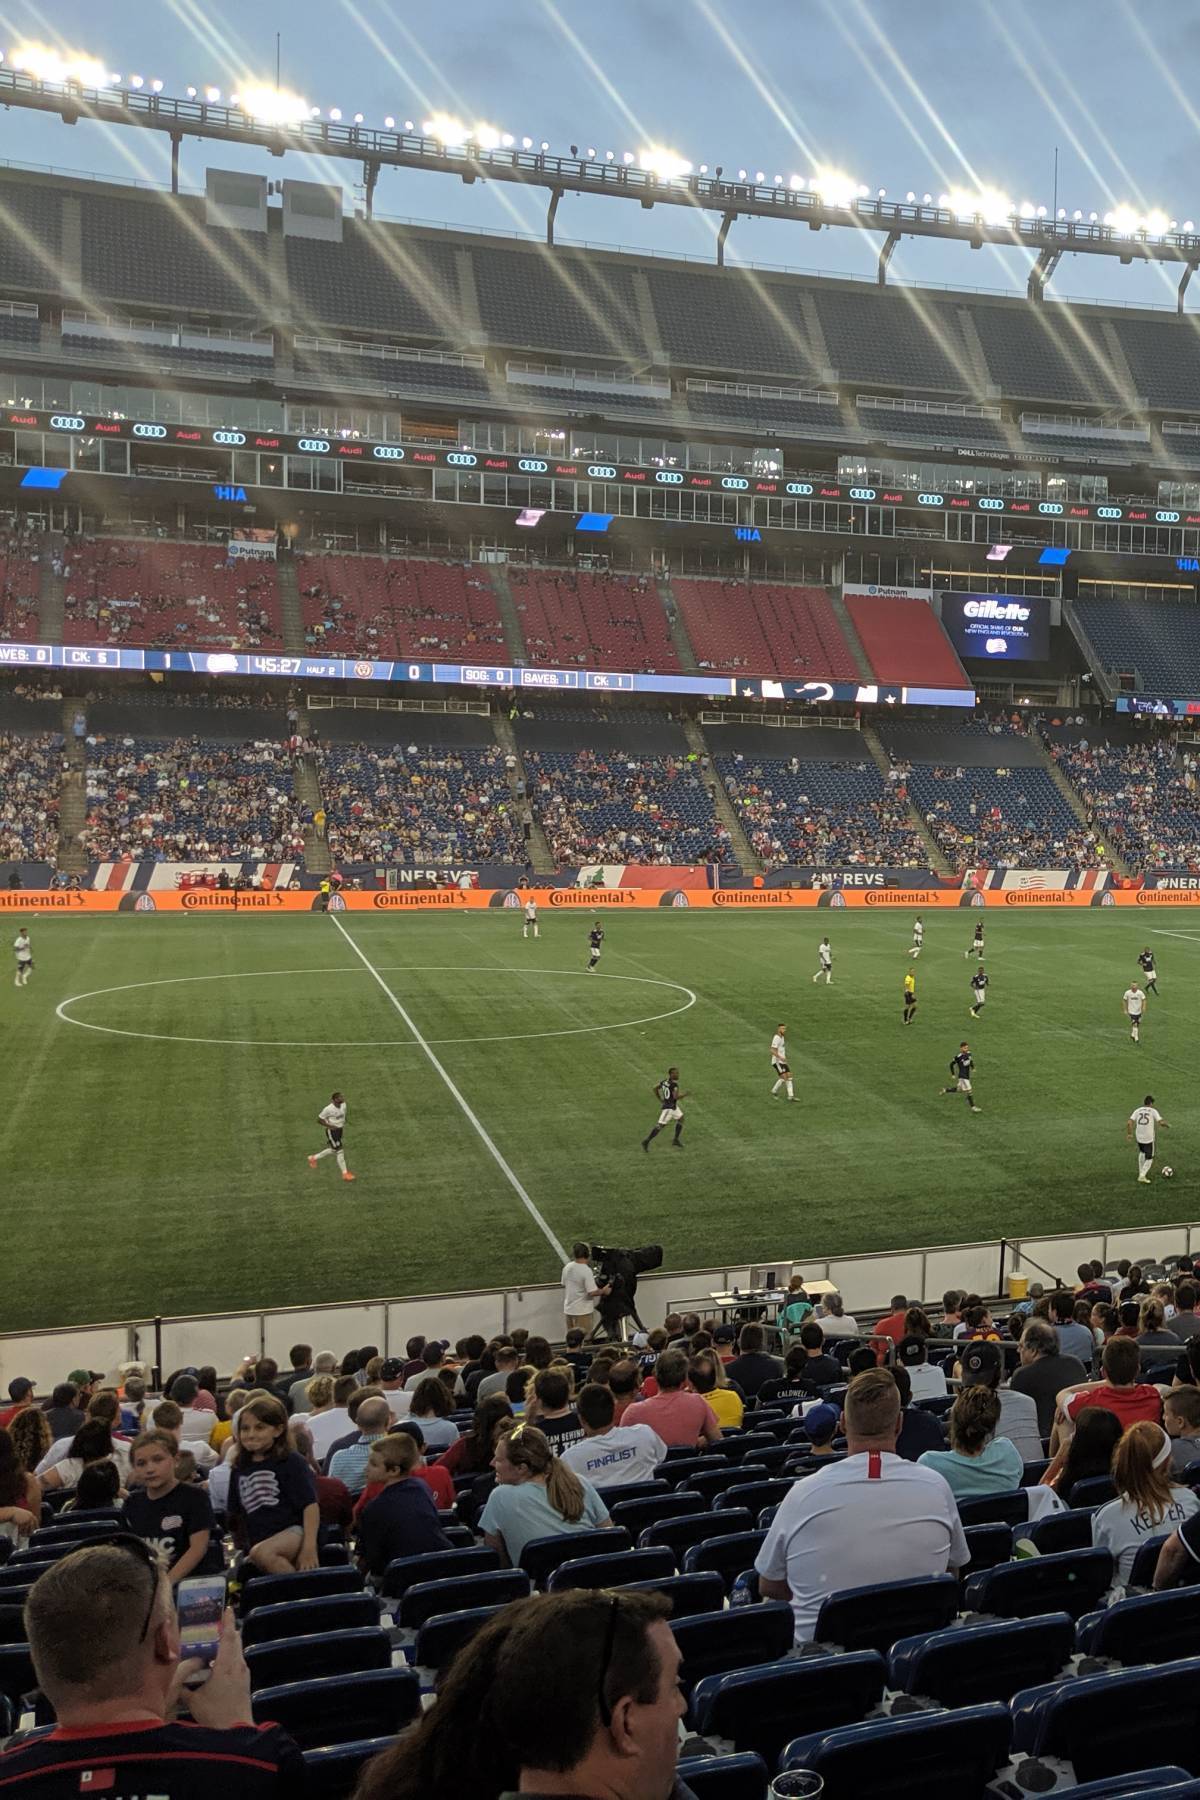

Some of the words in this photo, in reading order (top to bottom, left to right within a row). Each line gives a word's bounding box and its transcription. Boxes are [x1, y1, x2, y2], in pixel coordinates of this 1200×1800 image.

[10, 415, 37, 425] Audi
[95, 423, 121, 433] Audi
[176, 430, 201, 440] Audi
[255, 437, 280, 448] Audi
[339, 446, 362, 456] Audi
[958, 448, 975, 456] DELL
[413, 452, 436, 462] Audi
[485, 459, 508, 468] Audi
[556, 465, 577, 474] Audi
[624, 471, 645, 481] Audi
[691, 478, 712, 486] Audi
[756, 483, 777, 491] Audi
[820, 488, 840, 497] Audi
[883, 493, 903, 501] Audi
[951, 498, 970, 507] Audi
[1011, 503, 1030, 511] Audi
[1070, 507, 1089, 516] Audi
[1128, 511, 1147, 520] Audi
[878, 586, 907, 597] Putnam
[964, 600, 1029, 620] Gillette
[37, 650, 46, 661] 0
[72, 651, 91, 662] CK:
[164, 654, 171, 668] 1
[255, 659, 301, 673] 45:27
[306, 666, 326, 675] HALF
[328, 667, 336, 676] 2
[408, 665, 420, 680] 0
[465, 669, 490, 681] SOG:
[496, 671, 504, 682] 0
[524, 672, 559, 685] SAVES:
[565, 674, 570, 685] 1
[593, 676, 609, 687] CK:
[182, 892, 270, 909] Continental
[373, 892, 454, 908] Continental
[550, 890, 624, 906] Continental
[712, 890, 784, 906] Continental
[865, 891, 929, 905] Continental
[1005, 890, 1066, 905] Continental
[1136, 890, 1192, 905] Continental
[1138, 1113, 1149, 1125] 25
[562, 1429, 585, 1441] BEHIND
[586, 1446, 637, 1471] FINALIST
